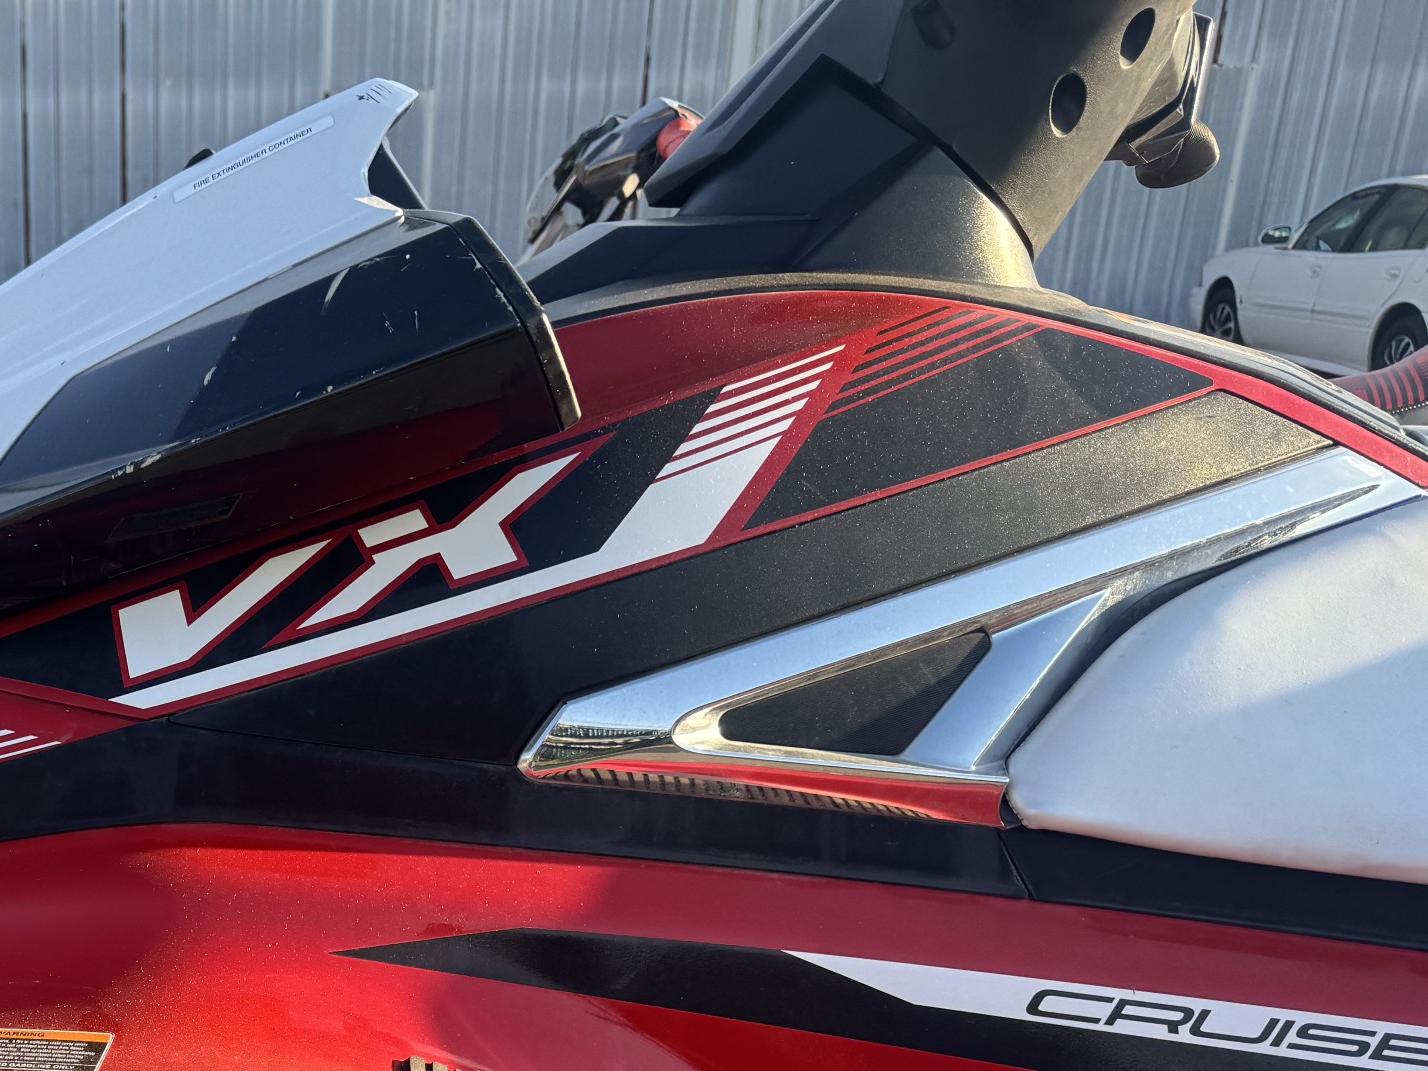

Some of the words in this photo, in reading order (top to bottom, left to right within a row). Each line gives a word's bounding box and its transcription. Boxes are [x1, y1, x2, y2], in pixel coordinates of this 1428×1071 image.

[192, 175, 211, 191] FIRE
[211, 148, 267, 180] EXTINGUISHER
[268, 127, 313, 153] CONTAINER
[116, 451, 583, 682] VX
